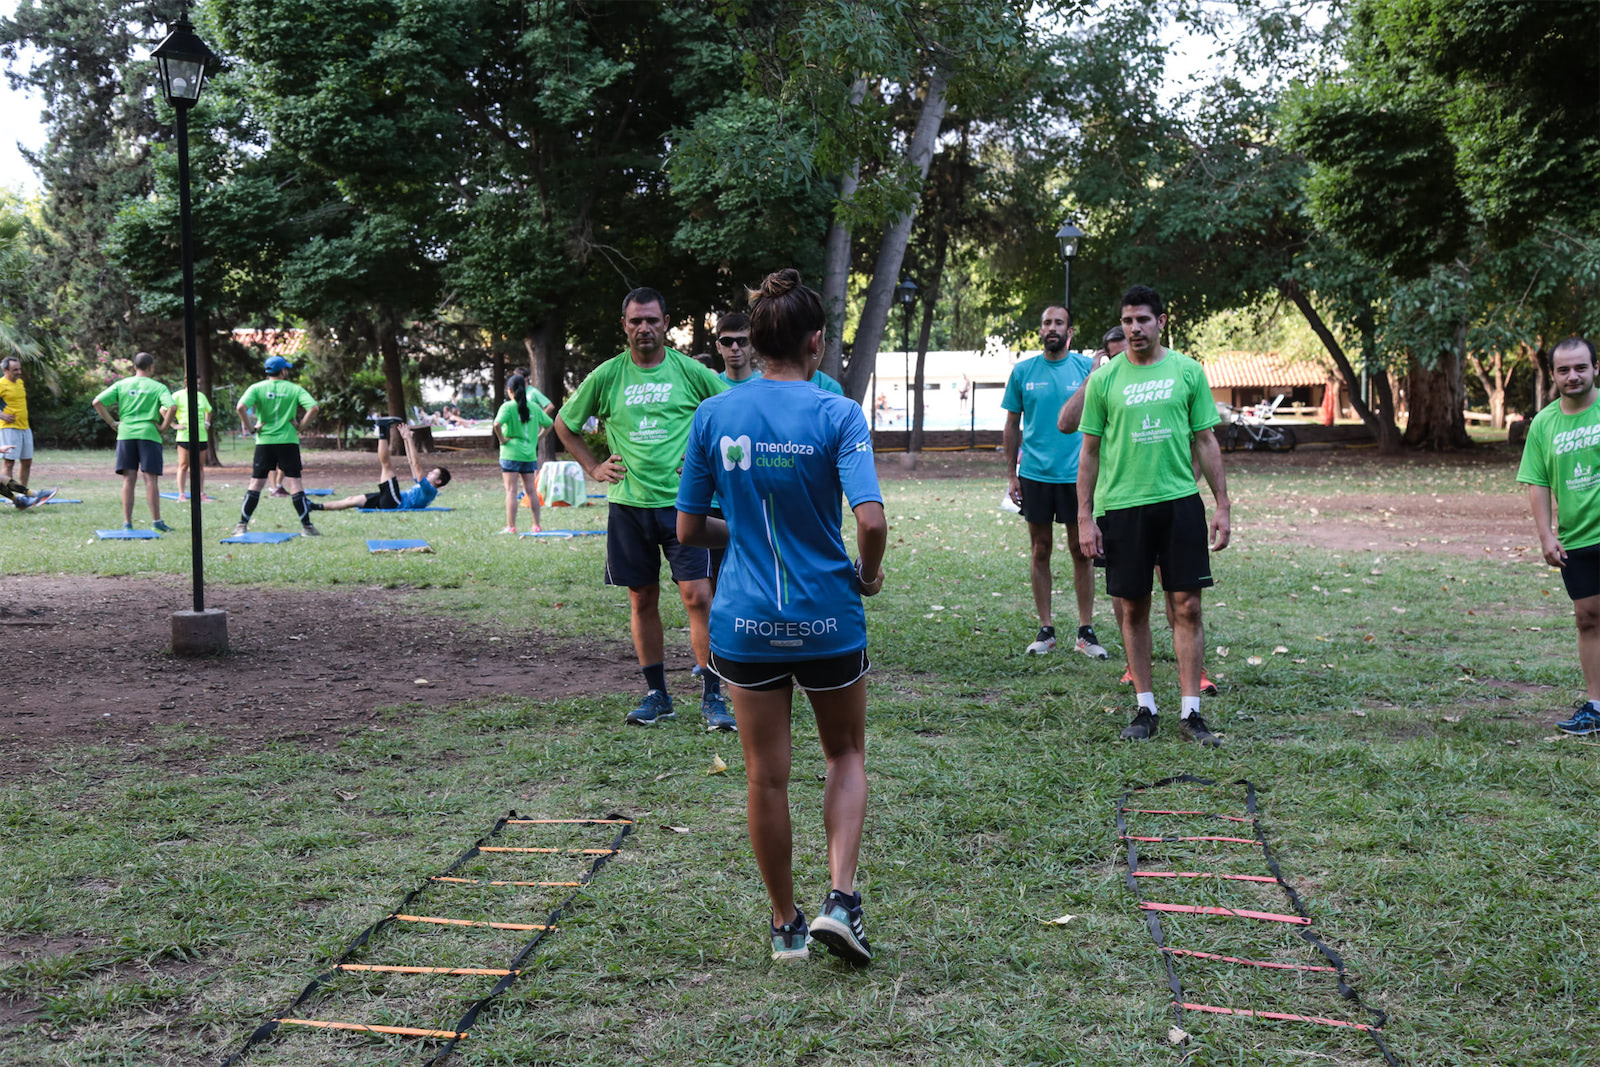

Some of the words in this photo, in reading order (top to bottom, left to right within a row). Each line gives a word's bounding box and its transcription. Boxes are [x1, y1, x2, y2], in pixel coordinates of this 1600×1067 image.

[624, 383, 673, 396] CIUDAD
[1123, 379, 1175, 395] CIUDAD
[625, 392, 671, 406] CORRE
[1125, 388, 1173, 406] CORRE
[1554, 424, 1600, 445] CIUDAD
[756, 440, 814, 455] mendoza
[1556, 434, 1600, 455] CORRE
[756, 454, 794, 468] ciudad
[734, 617, 838, 636] PROFESOR
